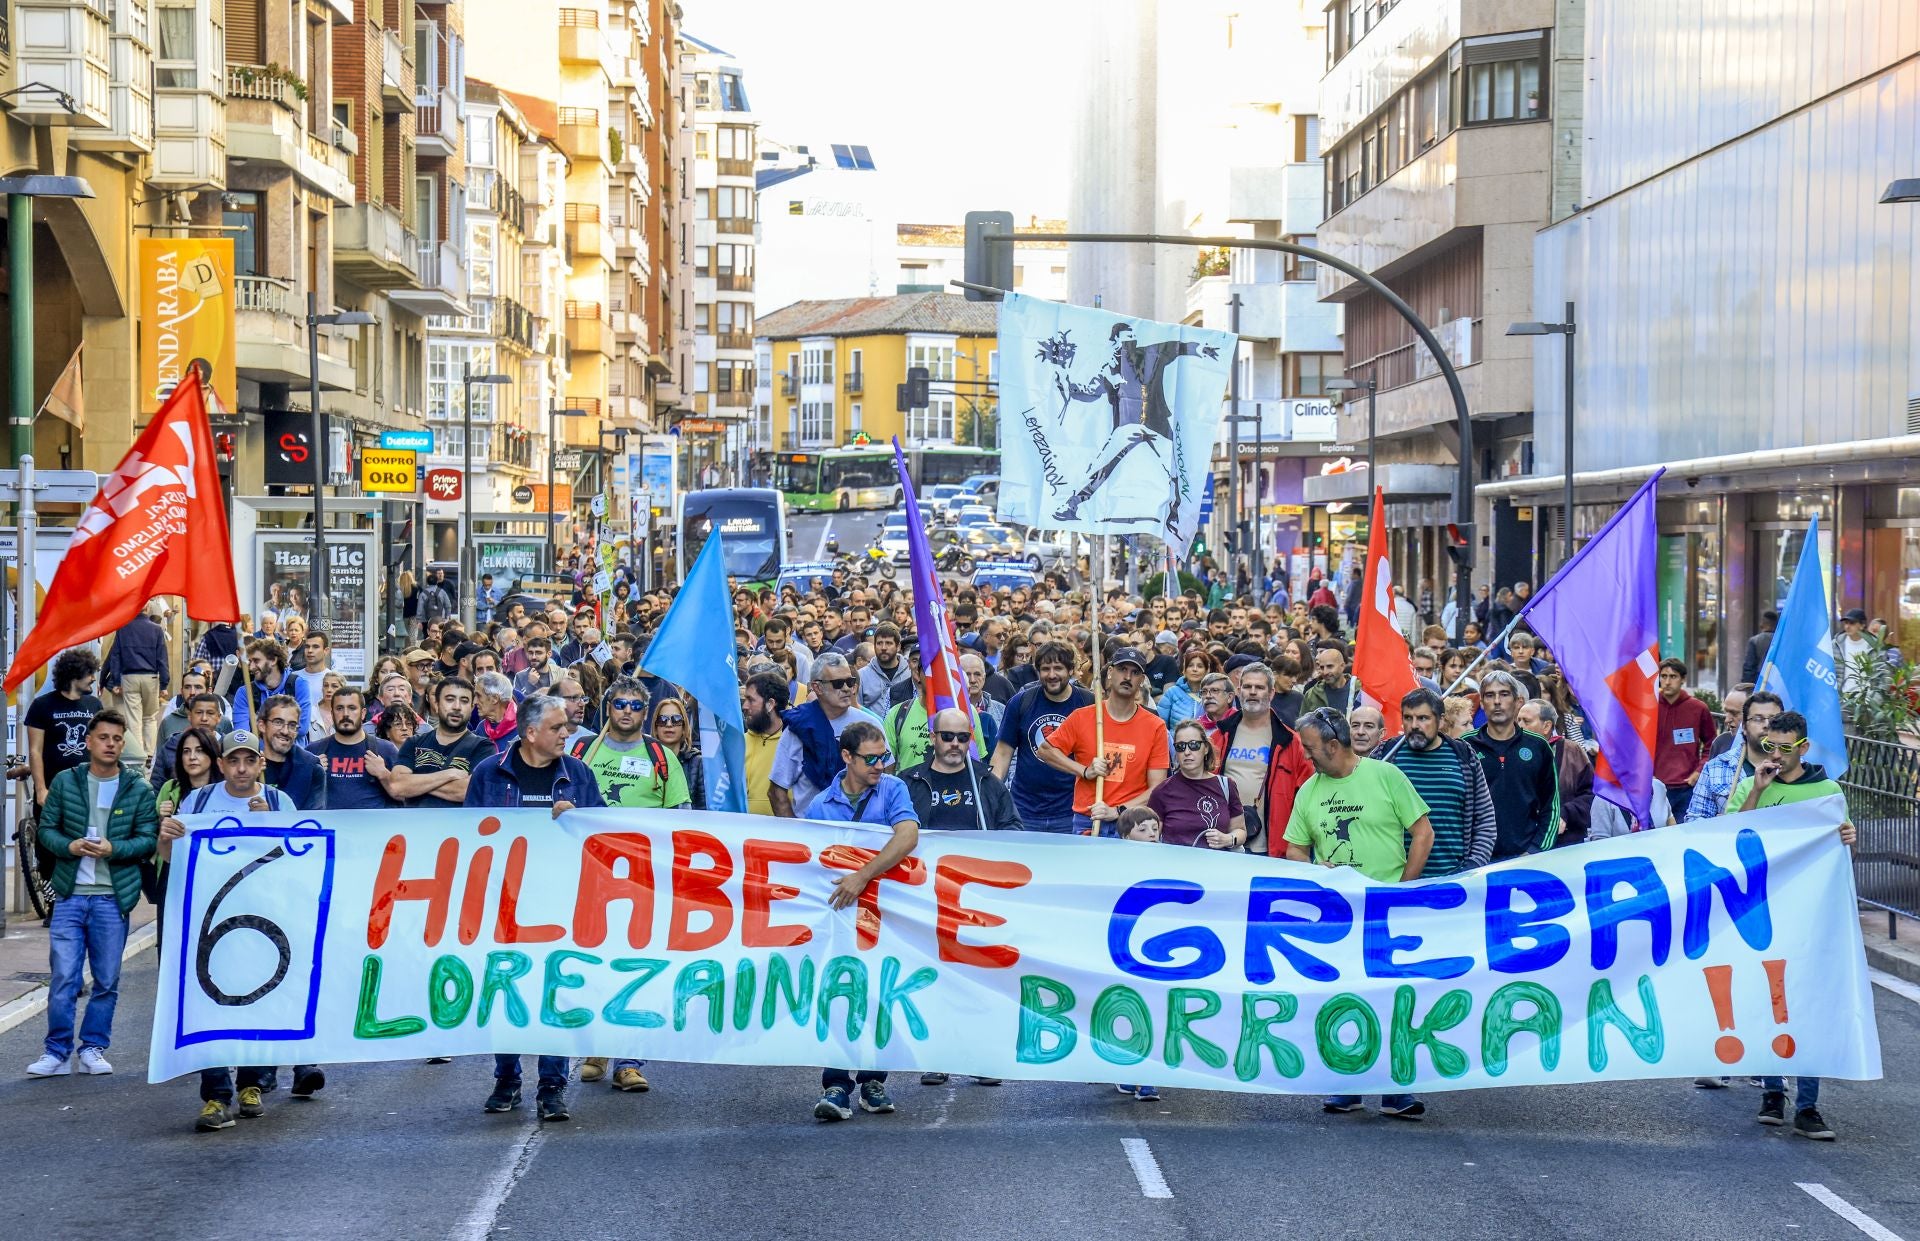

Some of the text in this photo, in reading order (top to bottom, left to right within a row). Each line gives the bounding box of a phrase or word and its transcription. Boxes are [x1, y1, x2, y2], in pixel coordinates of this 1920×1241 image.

[156, 251, 179, 401] DENDARABA
[1238, 444, 1279, 453] Ortooncia
[364, 457, 414, 466] COMPRO
[369, 472, 408, 484] ORO
[328, 546, 364, 567] lic
[484, 557, 536, 569] ELKARBIZI
[330, 567, 363, 575] cambia
[340, 576, 363, 586] chip
[1805, 657, 1839, 690] EUS
[602, 770, 640, 780] BORROKAN
[1328, 805, 1364, 813] BORROKAN
[1107, 828, 1773, 984] GREBAN
[196, 845, 291, 1007] 6
[353, 949, 939, 1050] LOREZAINAK
[1015, 974, 1665, 1087] BORROKAN
